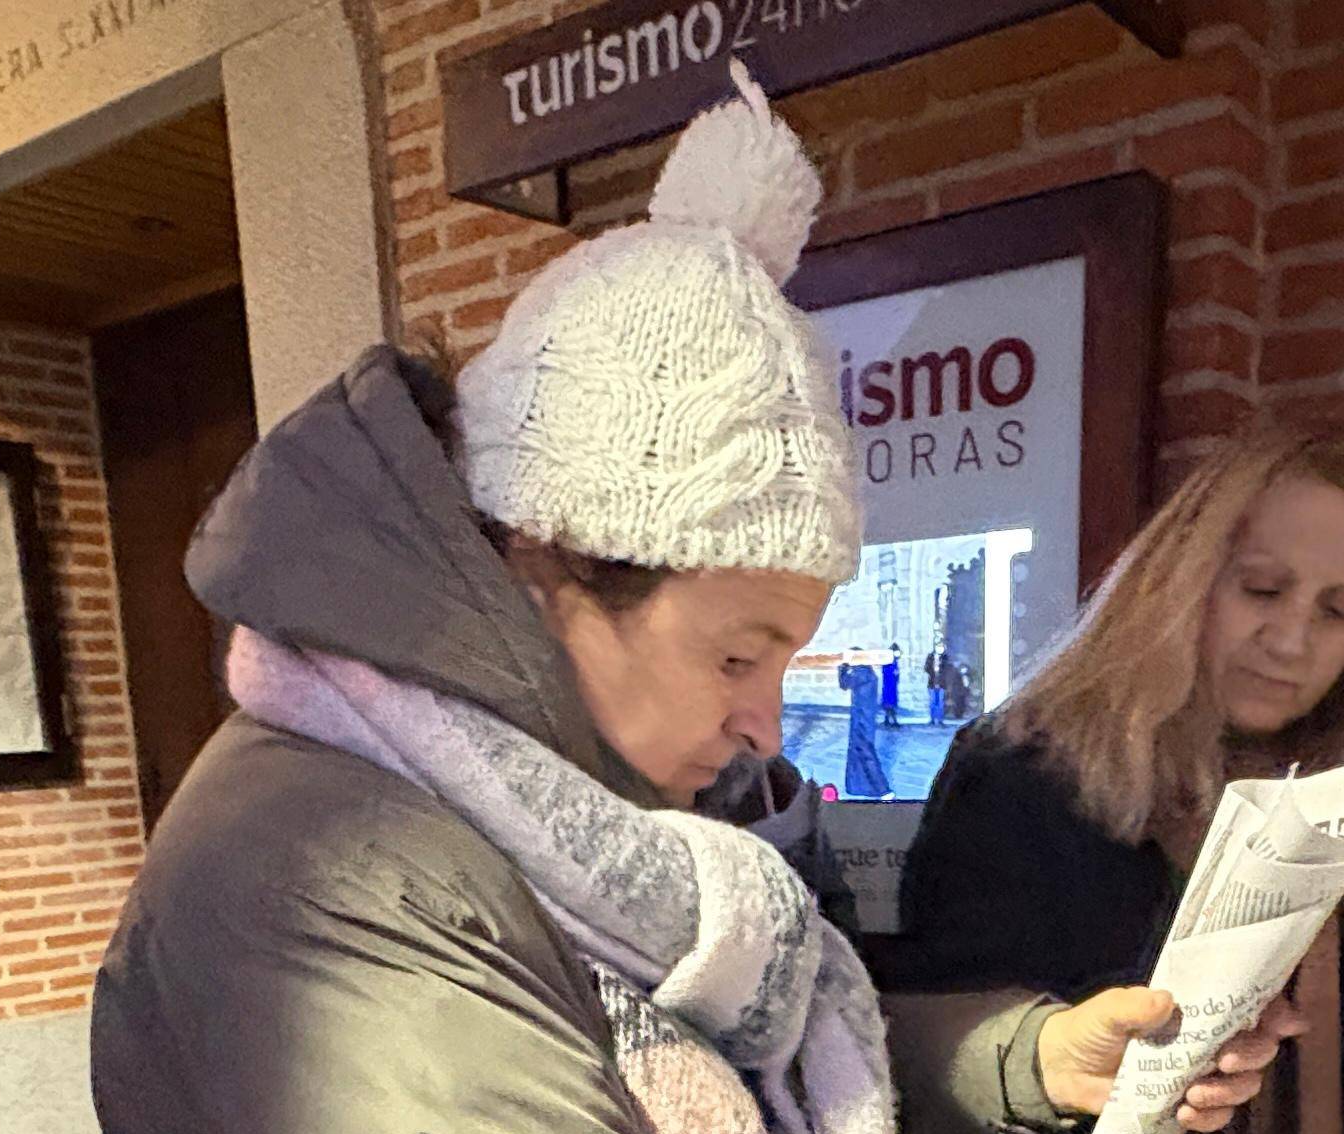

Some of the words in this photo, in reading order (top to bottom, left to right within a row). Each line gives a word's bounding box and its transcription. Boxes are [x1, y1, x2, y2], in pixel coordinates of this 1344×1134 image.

[502, 0, 723, 126] turismo
[840, 336, 1037, 429] ismo
[865, 420, 1026, 484] ORAS
